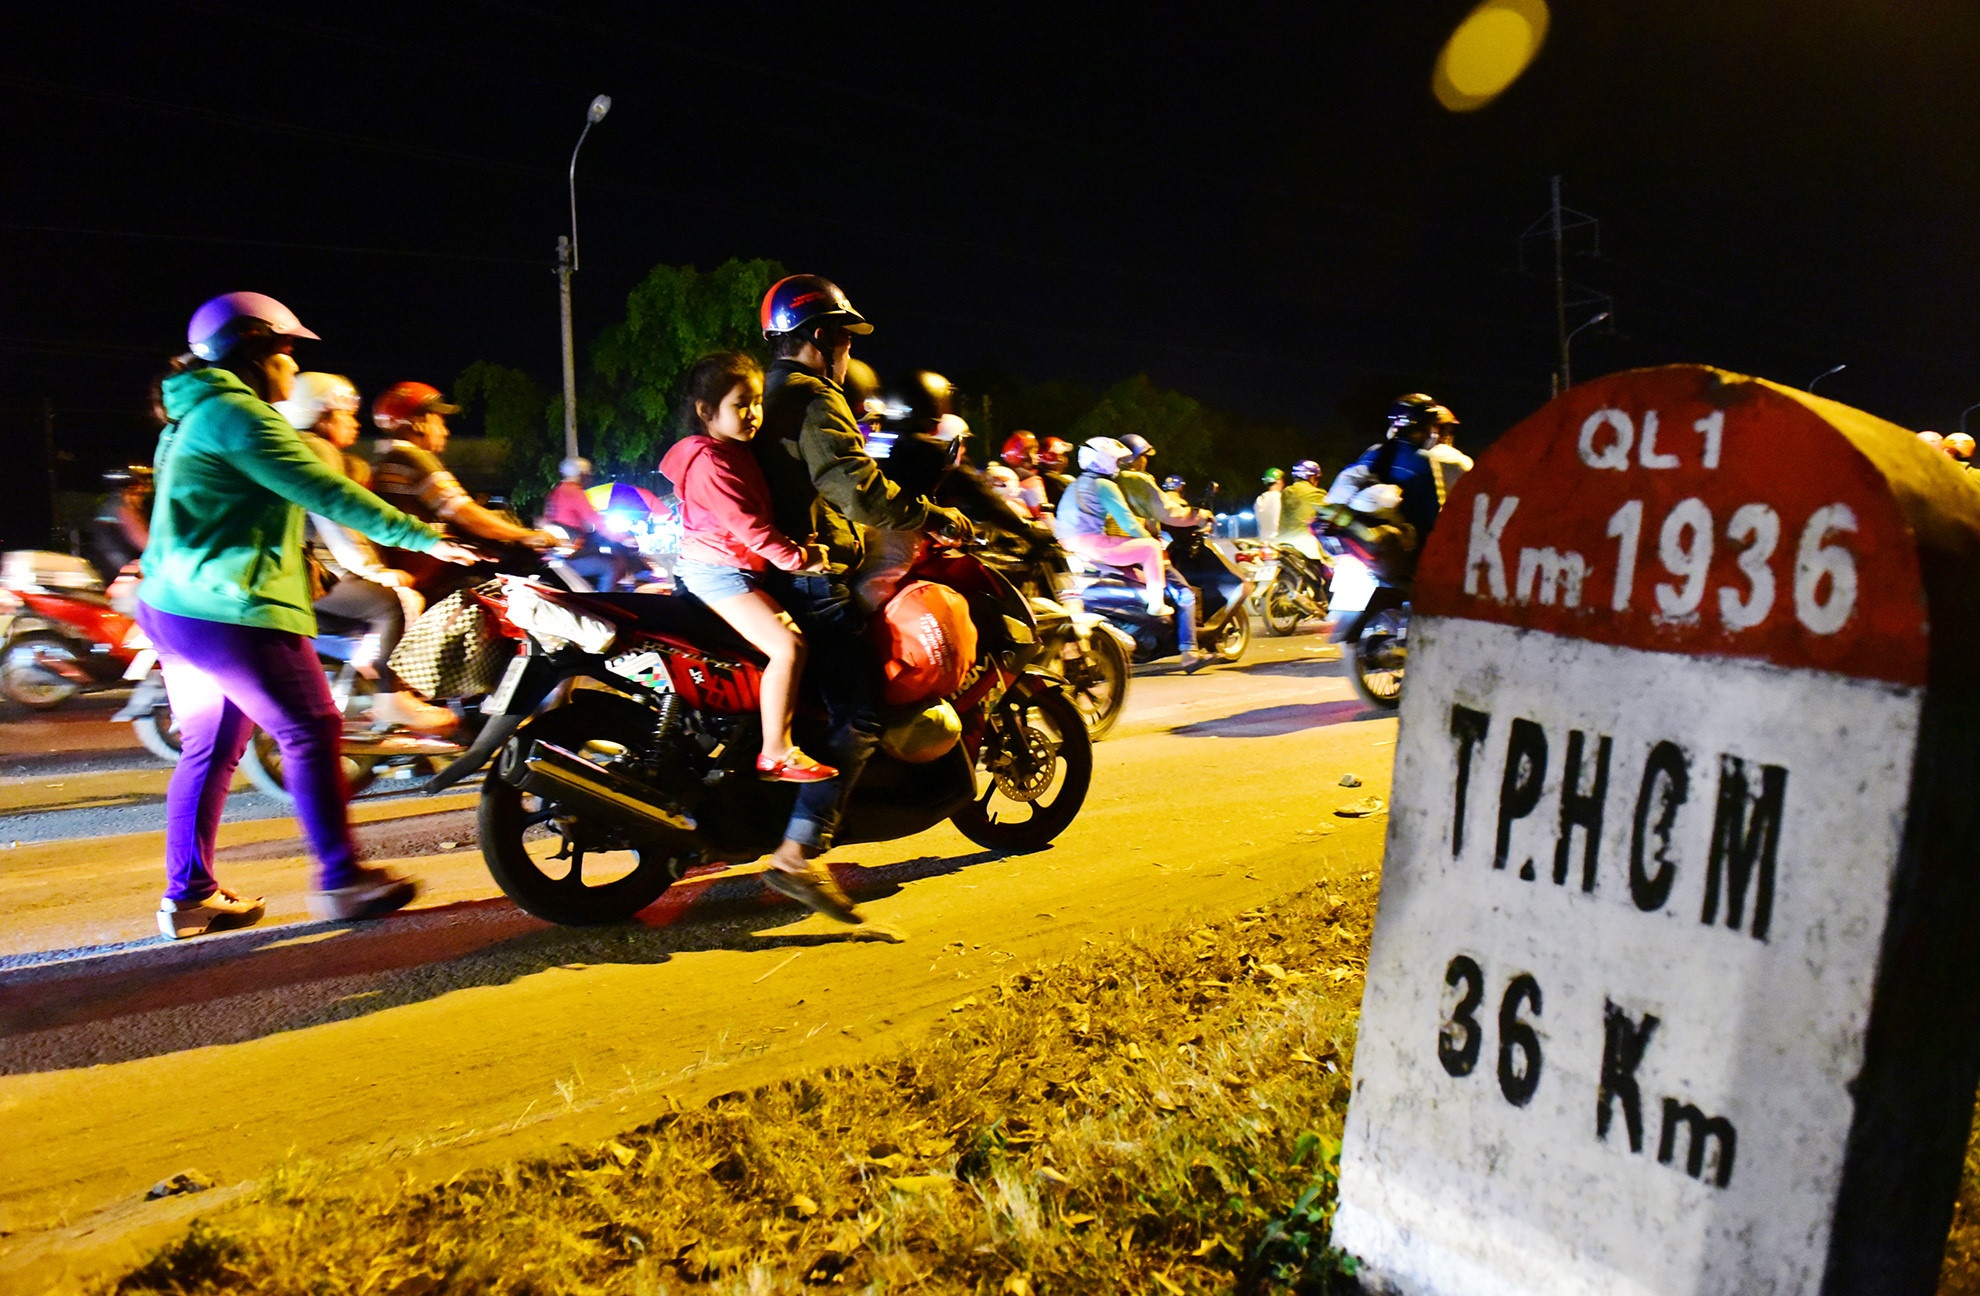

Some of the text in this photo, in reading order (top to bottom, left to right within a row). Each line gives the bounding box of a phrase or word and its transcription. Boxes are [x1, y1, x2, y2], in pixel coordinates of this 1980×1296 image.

[1576, 408, 1725, 471] QL 1
[1463, 491, 1860, 636] Km 1936
[1438, 954, 1737, 1190] 36 Km
